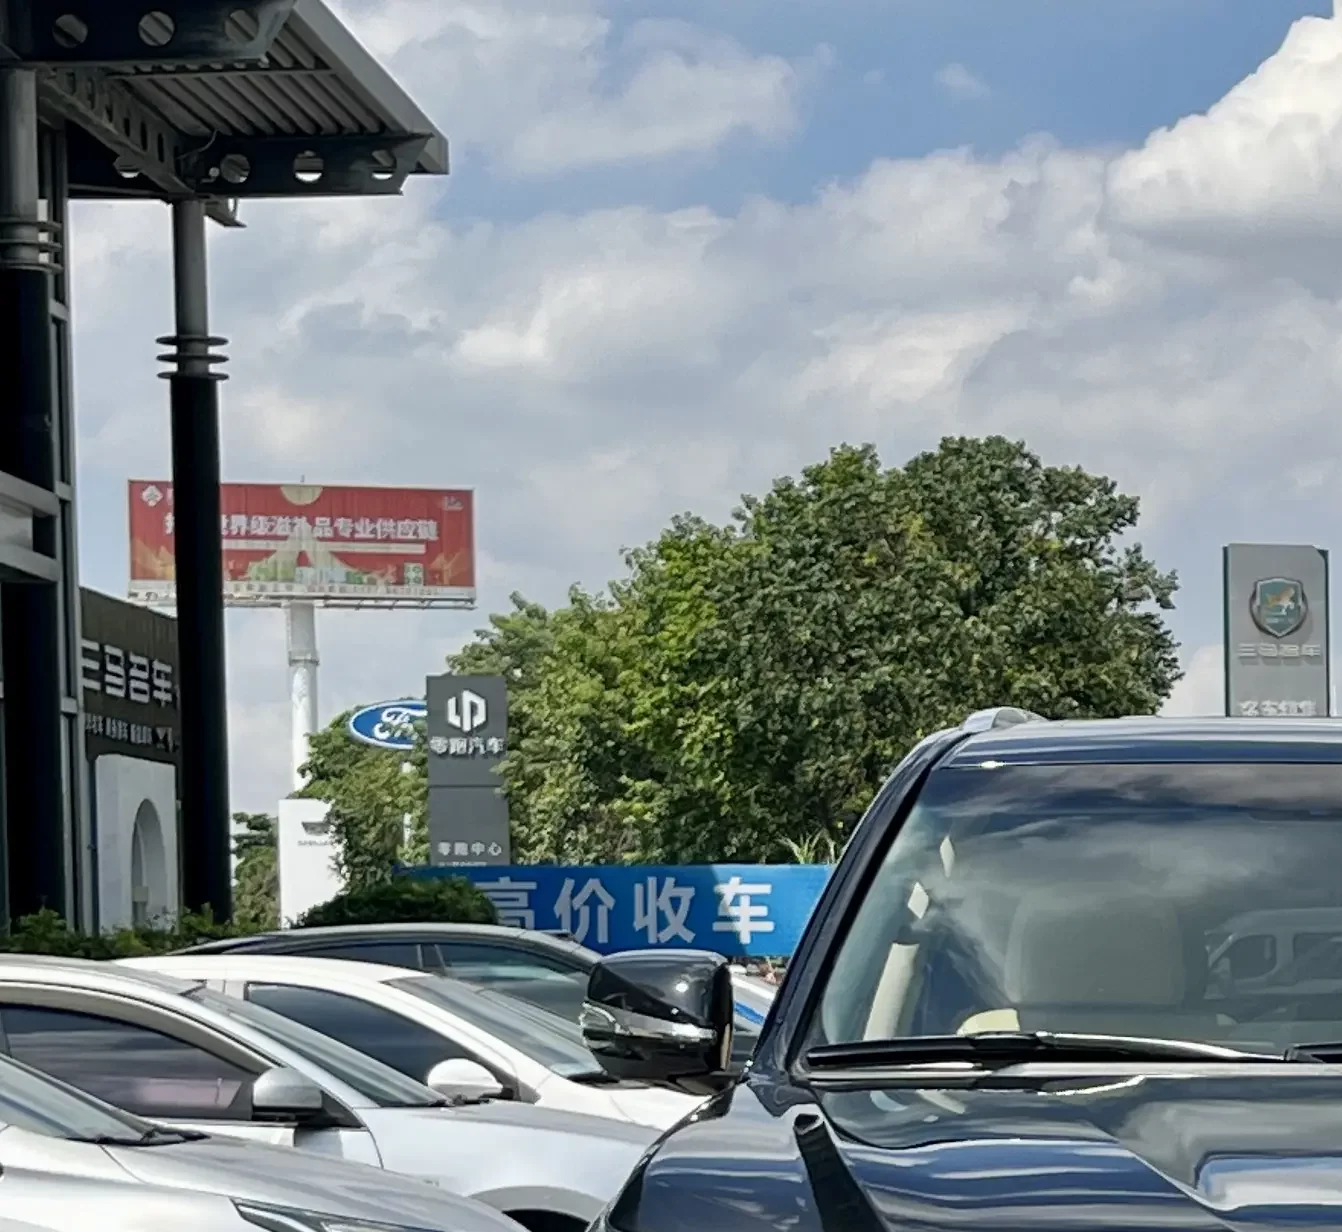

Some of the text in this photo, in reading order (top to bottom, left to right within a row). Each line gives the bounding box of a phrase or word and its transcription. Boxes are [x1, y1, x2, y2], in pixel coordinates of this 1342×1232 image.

[429, 736, 506, 755] 零跑汽车
[437, 841, 502, 856] 零跑中心
[474, 875, 775, 945] 高价收车
